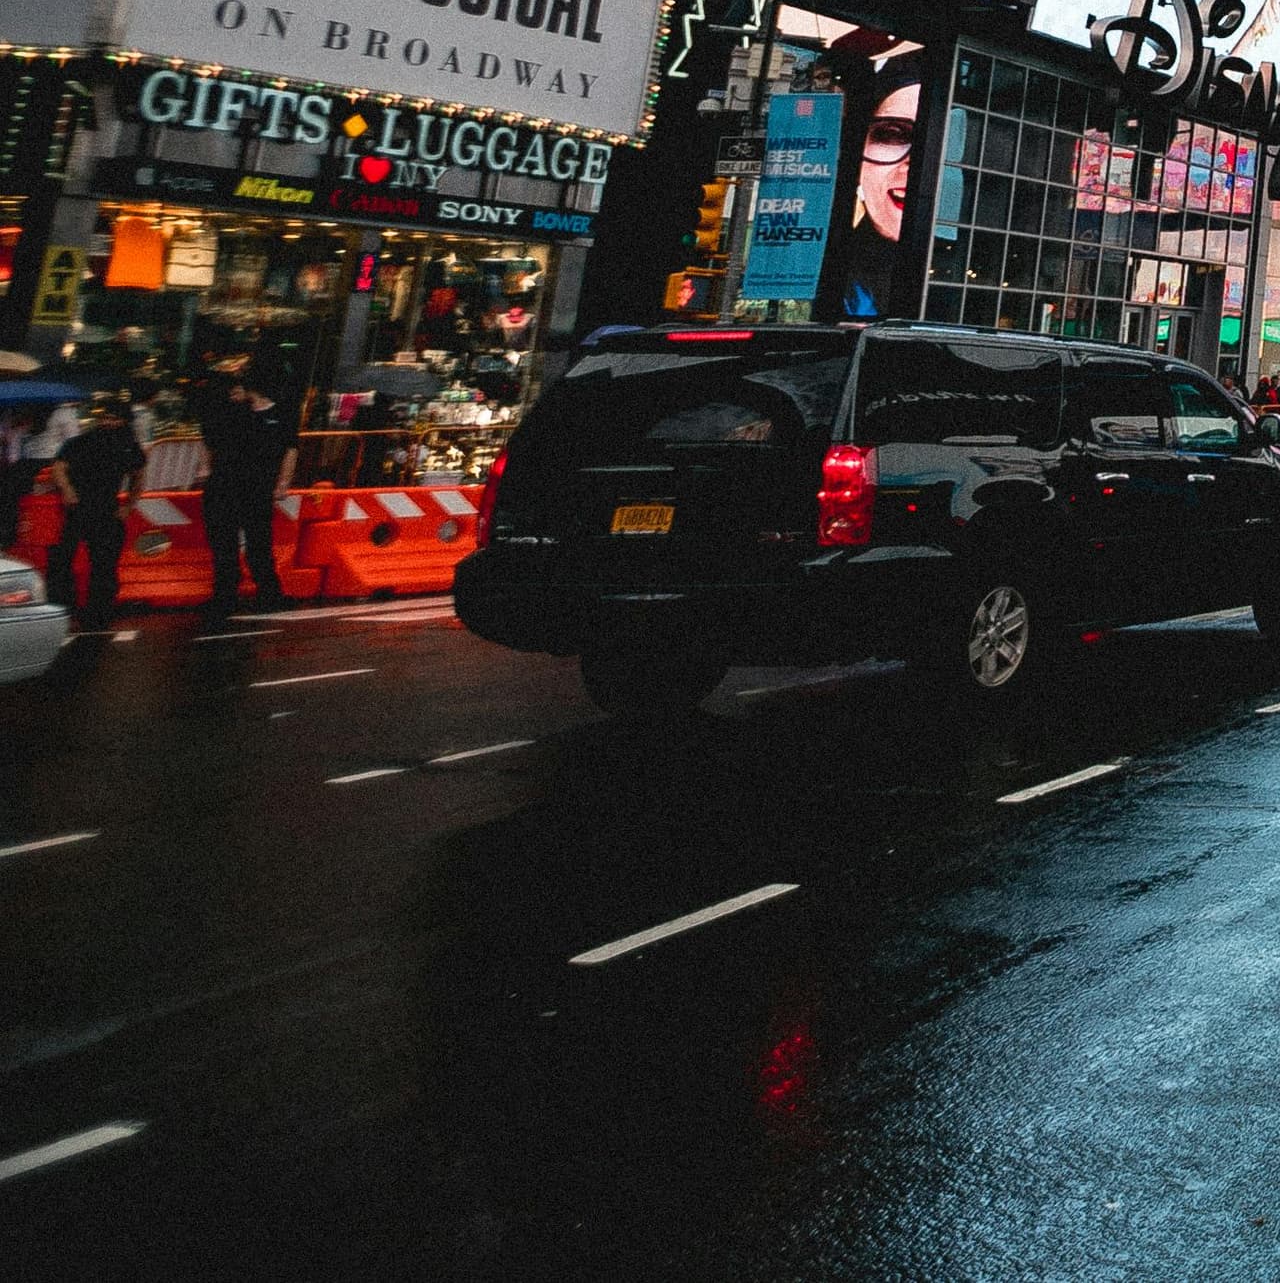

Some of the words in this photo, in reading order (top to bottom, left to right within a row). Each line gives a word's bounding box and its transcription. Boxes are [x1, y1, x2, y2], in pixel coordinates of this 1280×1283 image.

[323, 20, 599, 98] BROADWAY
[139, 70, 333, 144] GIFTS
[376, 109, 613, 185] LUGGAGE
[768, 138, 828, 150] WINNER
[768, 150, 806, 162] BEST
[389, 161, 448, 192] NY
[764, 163, 831, 176] MUSICAL
[232, 176, 315, 204] Nikon
[330, 189, 420, 216] Canon
[437, 201, 523, 225] SONY
[759, 199, 805, 214] DEAR
[533, 211, 593, 233] BOWER
[758, 214, 799, 227] EVAN
[756, 227, 824, 242] HANSEN
[41, 251, 75, 312] ATM
